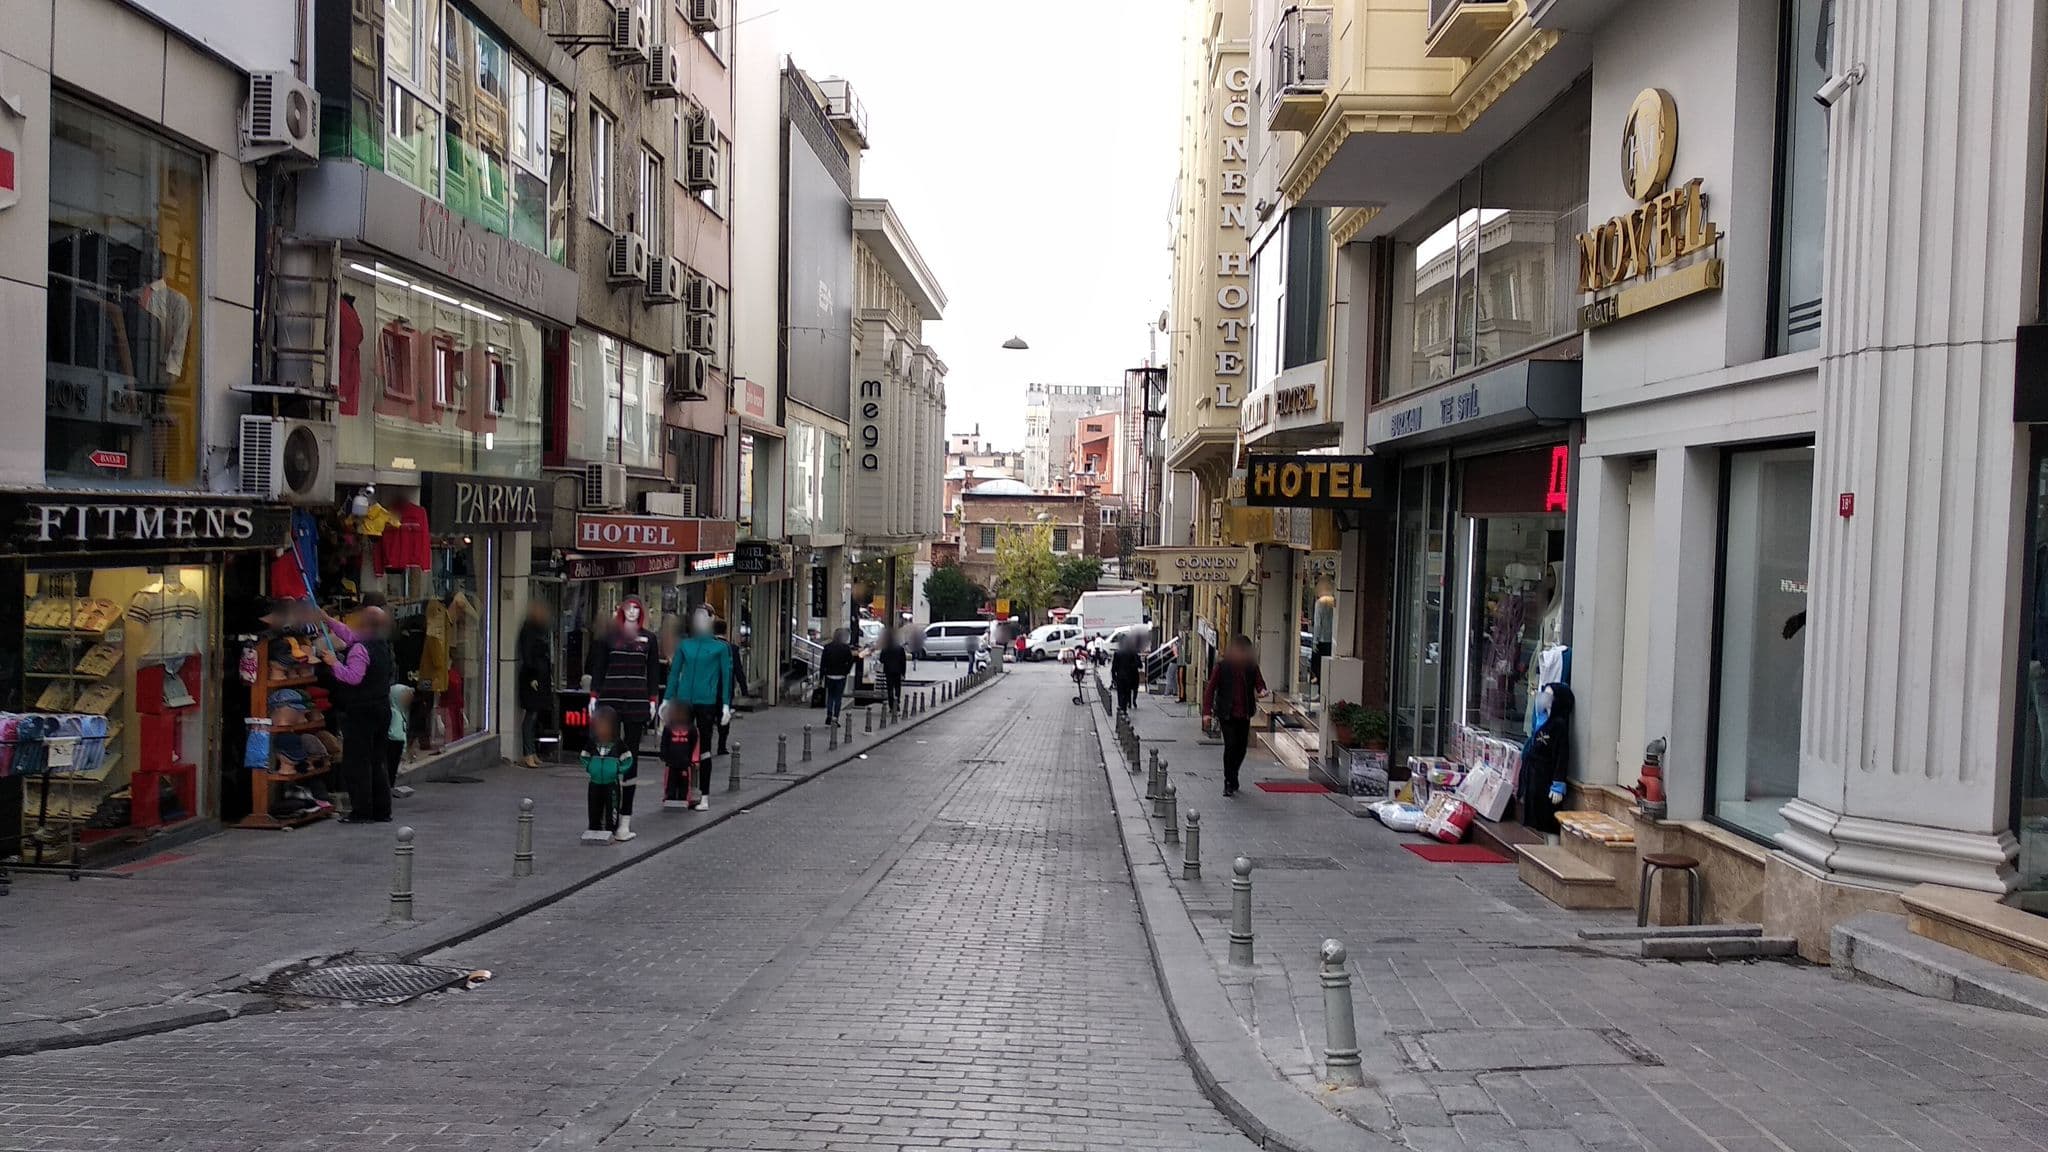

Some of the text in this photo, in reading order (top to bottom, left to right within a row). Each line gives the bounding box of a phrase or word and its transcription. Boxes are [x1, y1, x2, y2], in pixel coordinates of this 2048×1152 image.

[1215, 67, 1249, 408] GÖNEN HOTEL
[1577, 178, 1717, 291] NOVEL
[1277, 383, 1318, 418] HOTEL
[860, 379, 882, 470] mega
[1253, 461, 1373, 499] HOTEL
[454, 481, 538, 524] PARMA
[36, 504, 255, 542] FITMENS
[581, 522, 676, 545] HOTEL
[1175, 554, 1238, 569] GÖNEN
[1181, 571, 1229, 582] HOTEL
